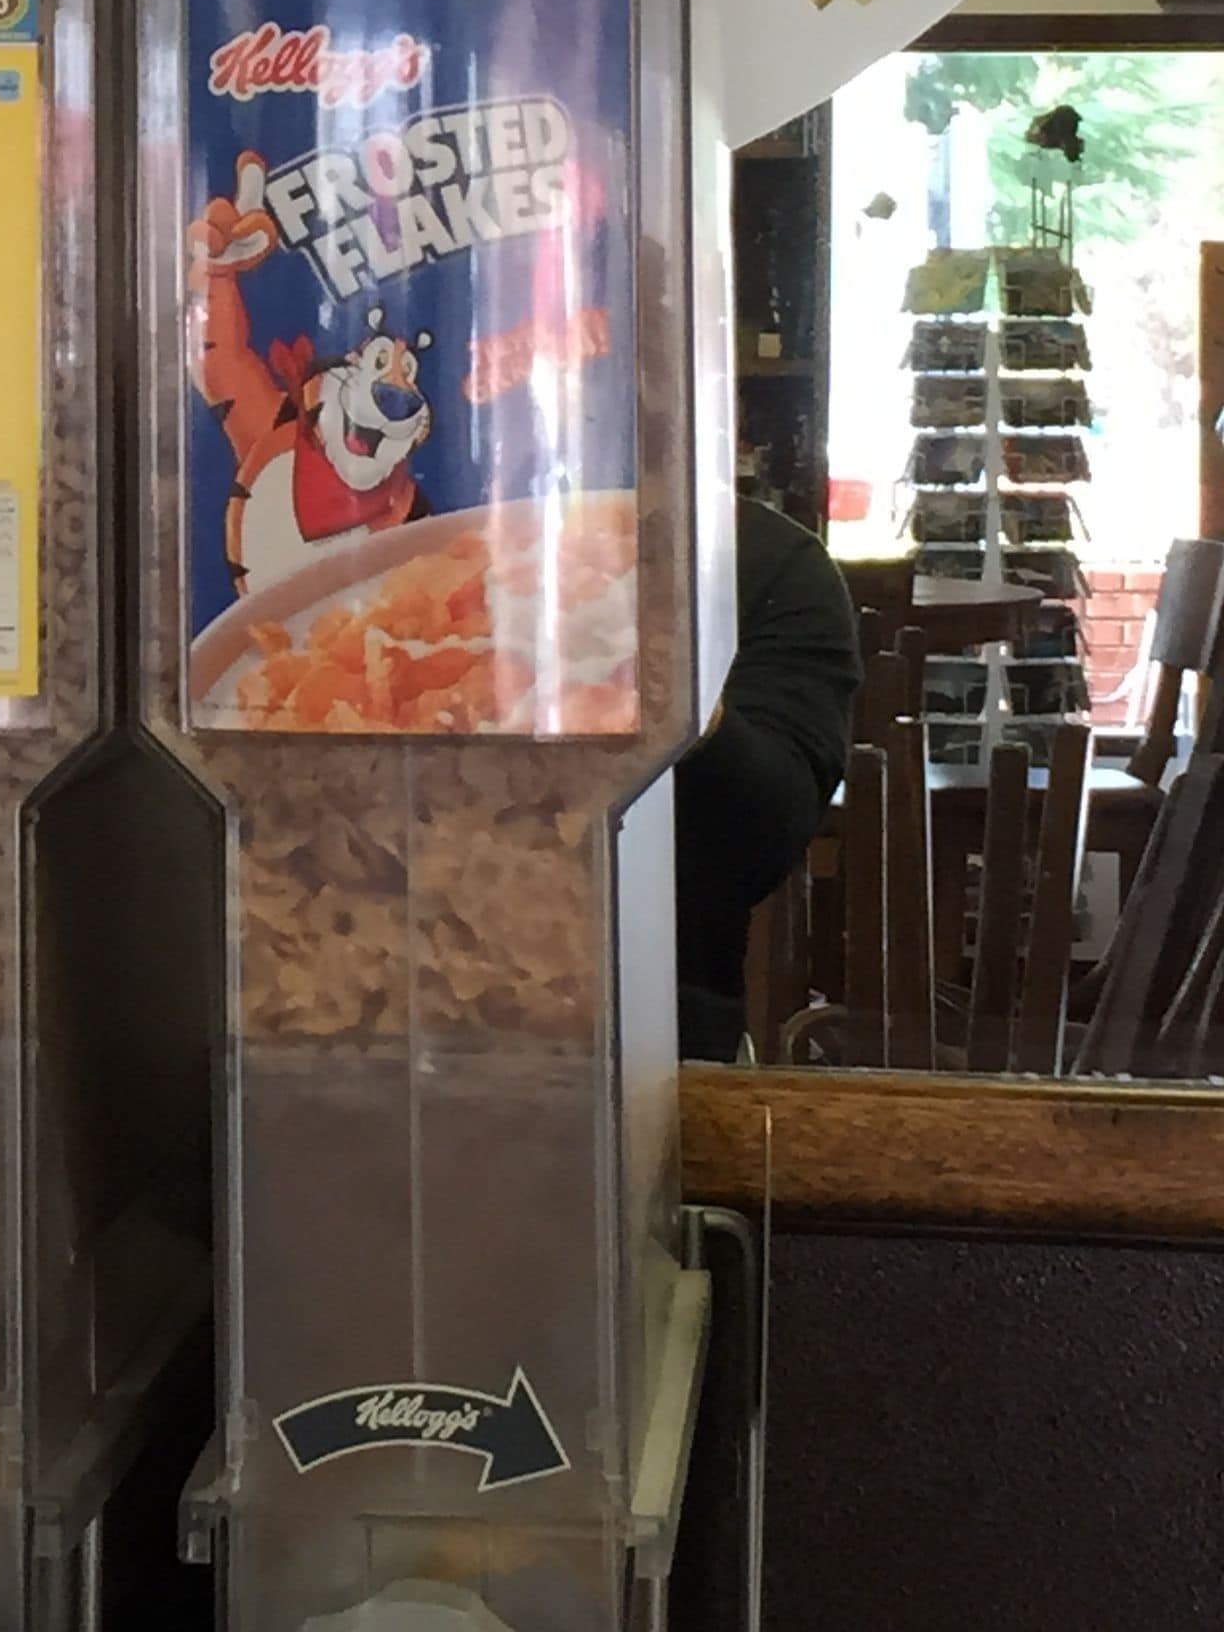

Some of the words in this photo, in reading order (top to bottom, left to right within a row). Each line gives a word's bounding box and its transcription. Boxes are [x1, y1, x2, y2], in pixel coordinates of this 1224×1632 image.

[209, 22, 431, 109] Kellogg's
[265, 99, 569, 249] FROSTED
[311, 165, 573, 302] FLAKES
[355, 1389, 481, 1440] Kellogg's
